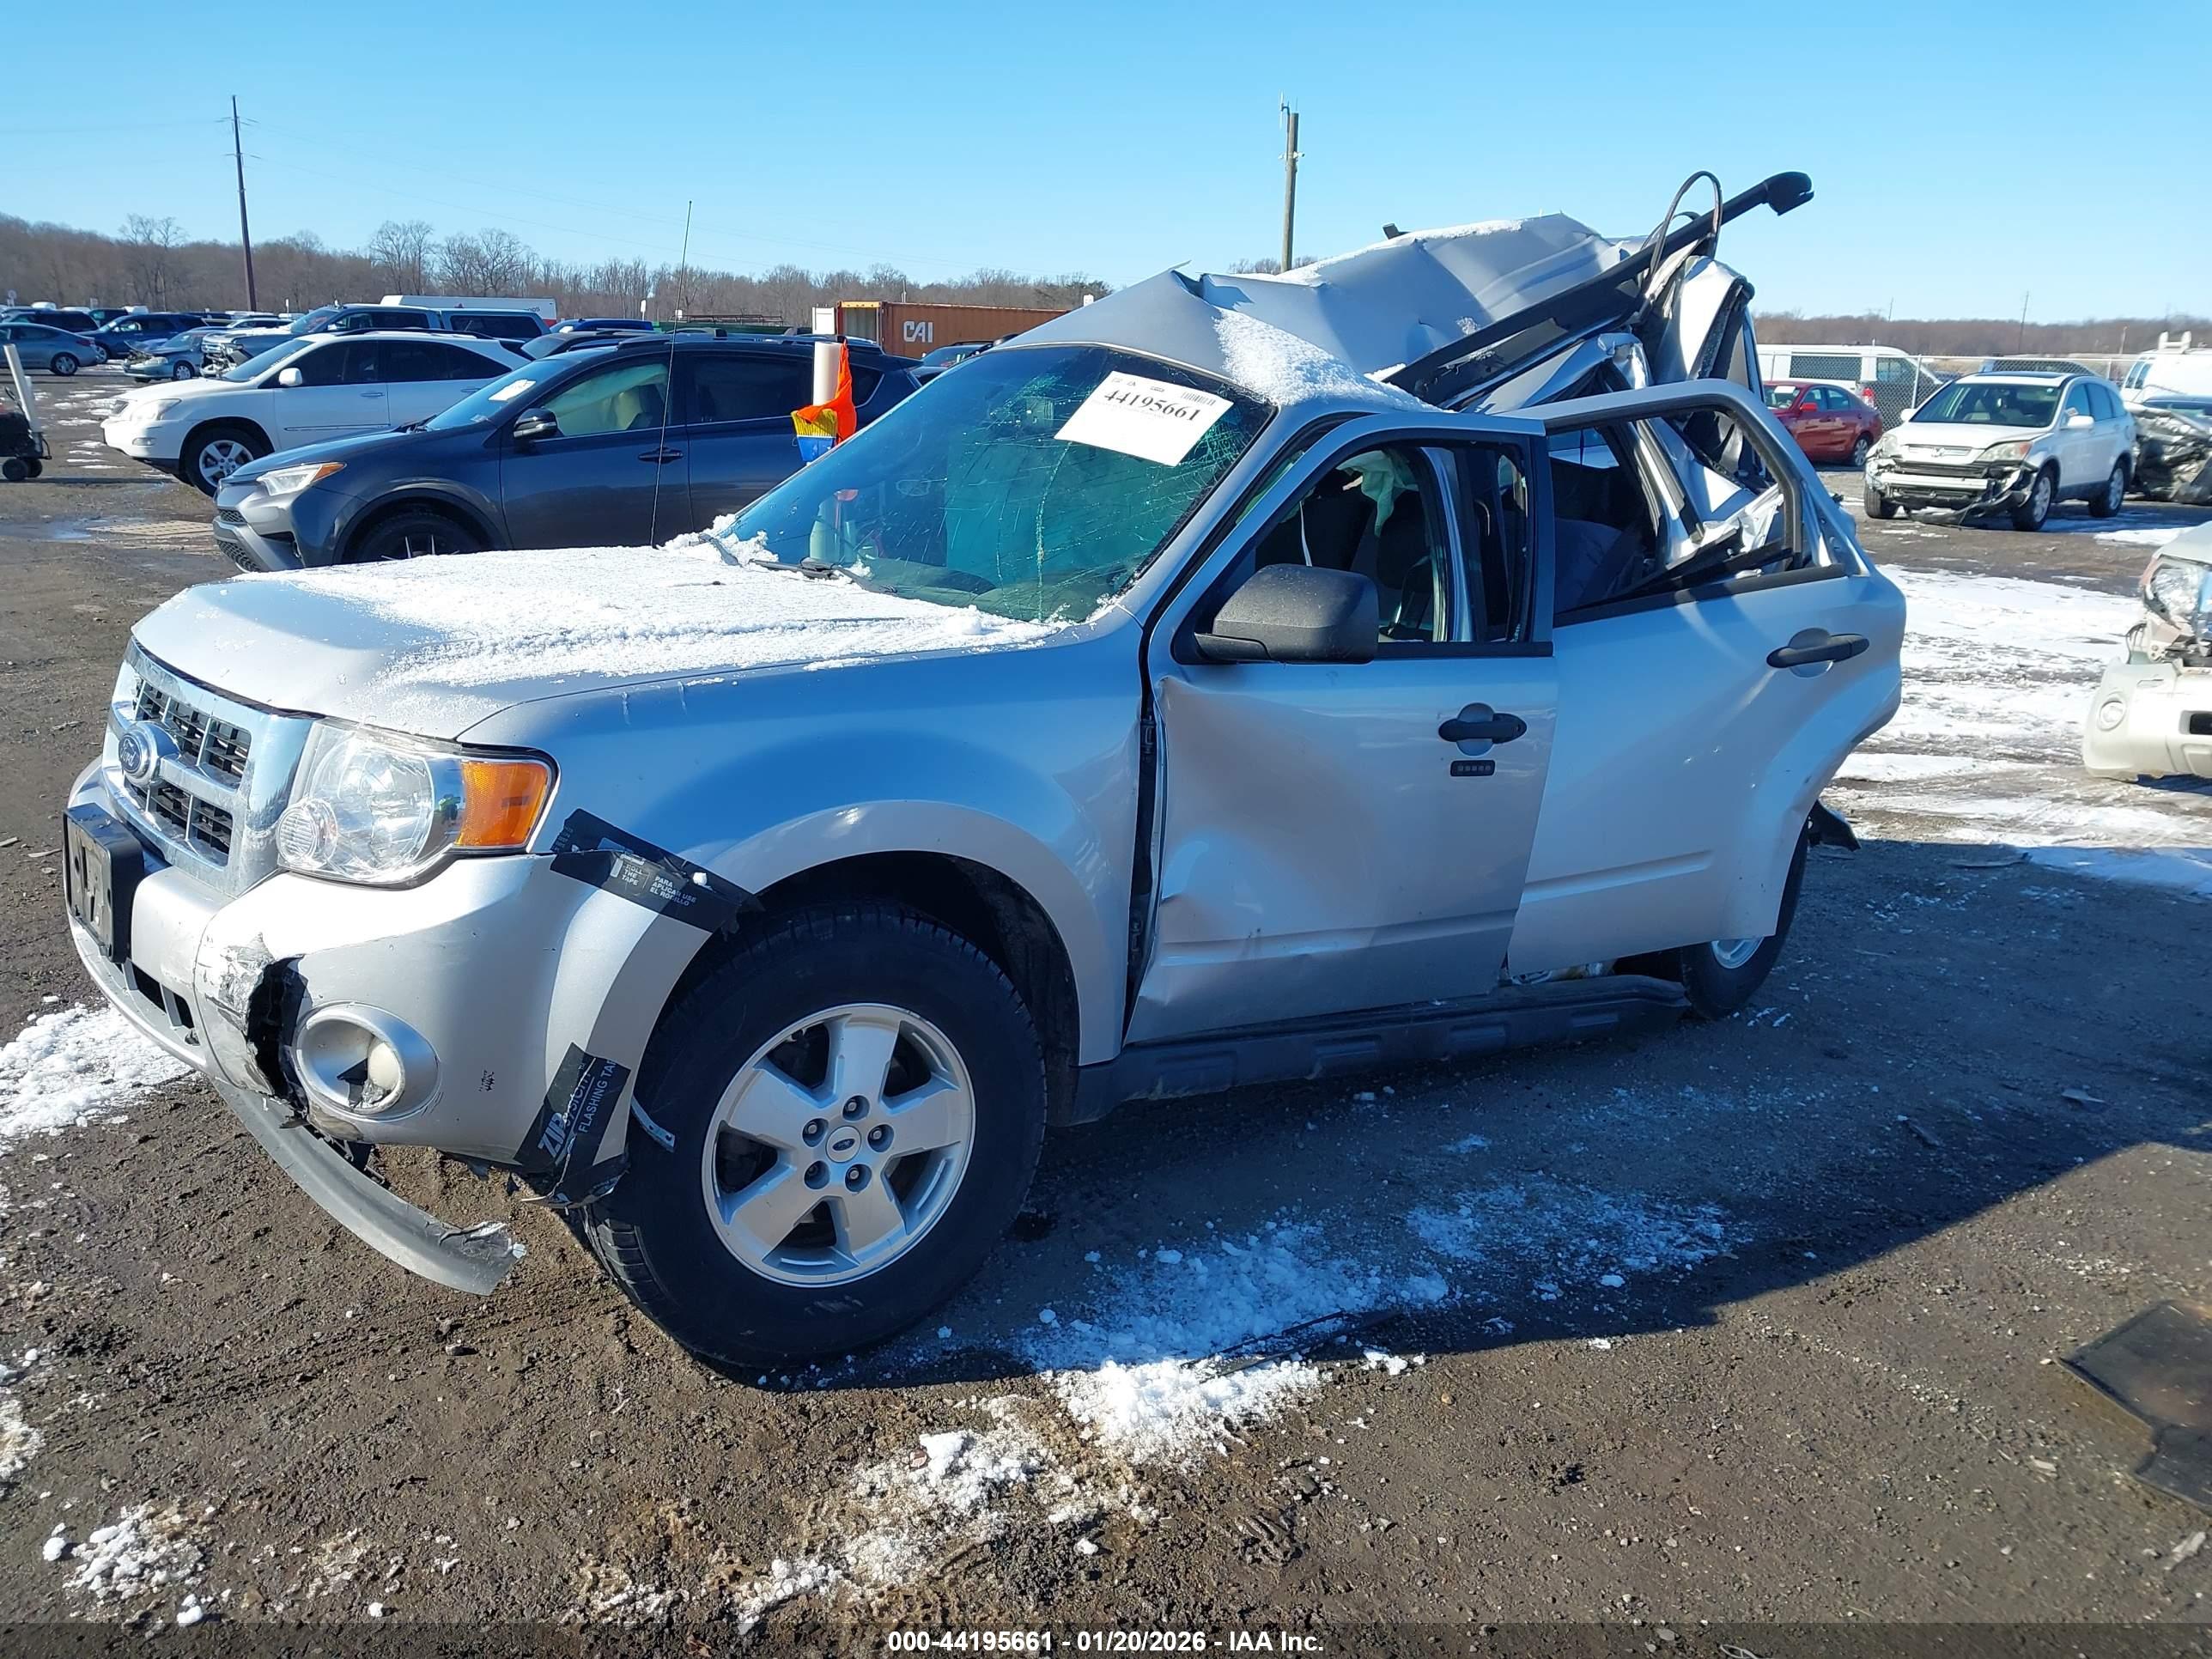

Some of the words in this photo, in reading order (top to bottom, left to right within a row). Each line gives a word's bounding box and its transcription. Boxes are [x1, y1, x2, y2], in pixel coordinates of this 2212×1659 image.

[903, 320, 933, 343] CAI
[1103, 389, 1201, 422] 44195661
[120, 738, 137, 768] Ford
[623, 869, 638, 879] THE
[625, 863, 643, 875] ROLL
[621, 874, 640, 886] TAPE
[654, 876, 674, 888] PARA
[649, 886, 659, 895] EL
[682, 892, 697, 903] USE
[578, 1079, 608, 1133] FLASHING
[538, 1112, 566, 1158] ZIP
